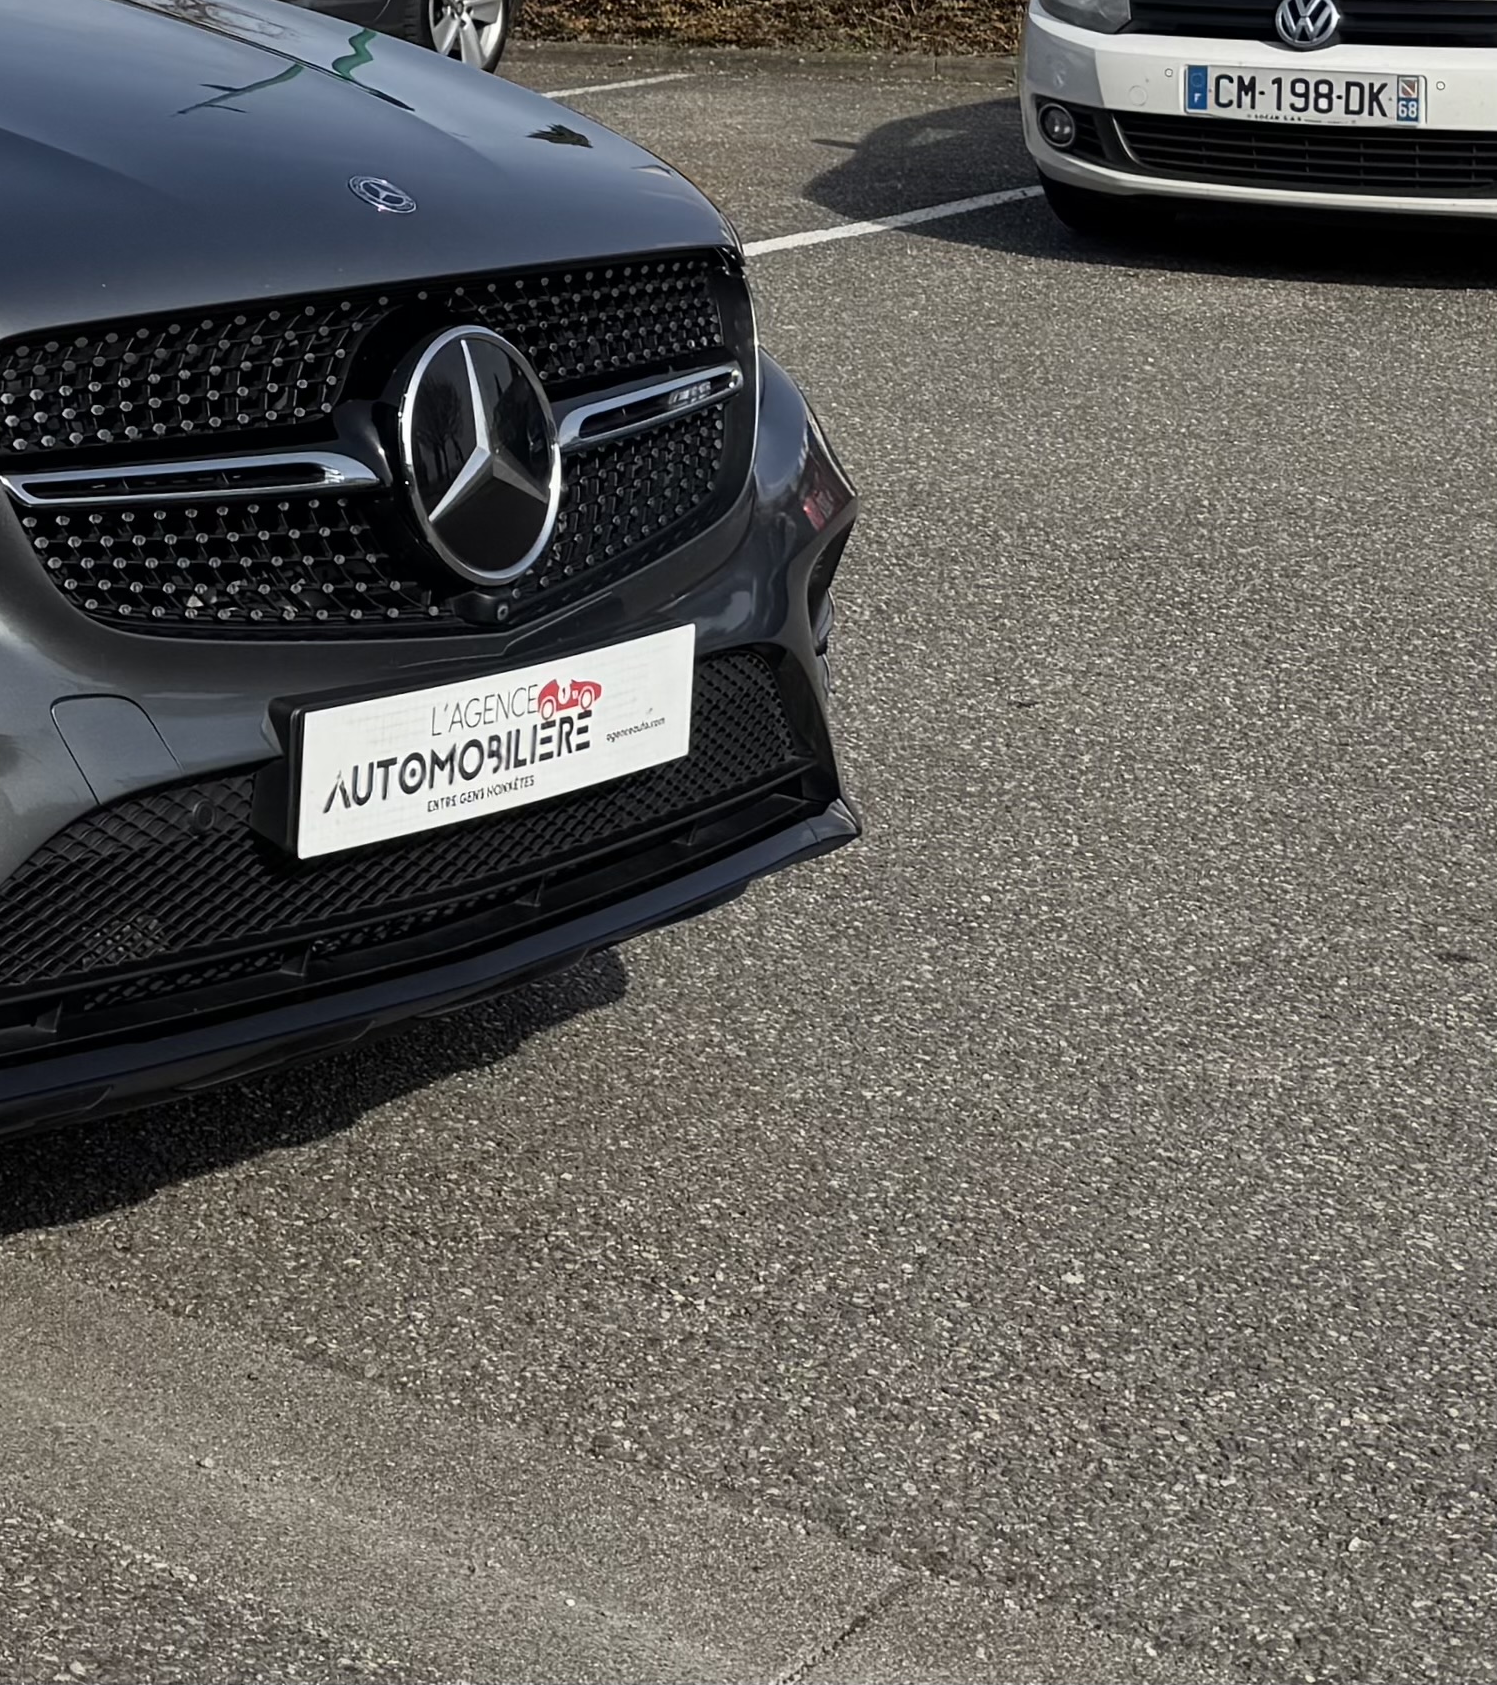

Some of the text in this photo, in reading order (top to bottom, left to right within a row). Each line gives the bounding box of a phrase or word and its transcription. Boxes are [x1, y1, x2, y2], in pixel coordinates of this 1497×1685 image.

[1214, 73, 1389, 118] CM-198-DK
[1398, 100, 1418, 118] 68
[431, 684, 539, 736] L'AGENCE
